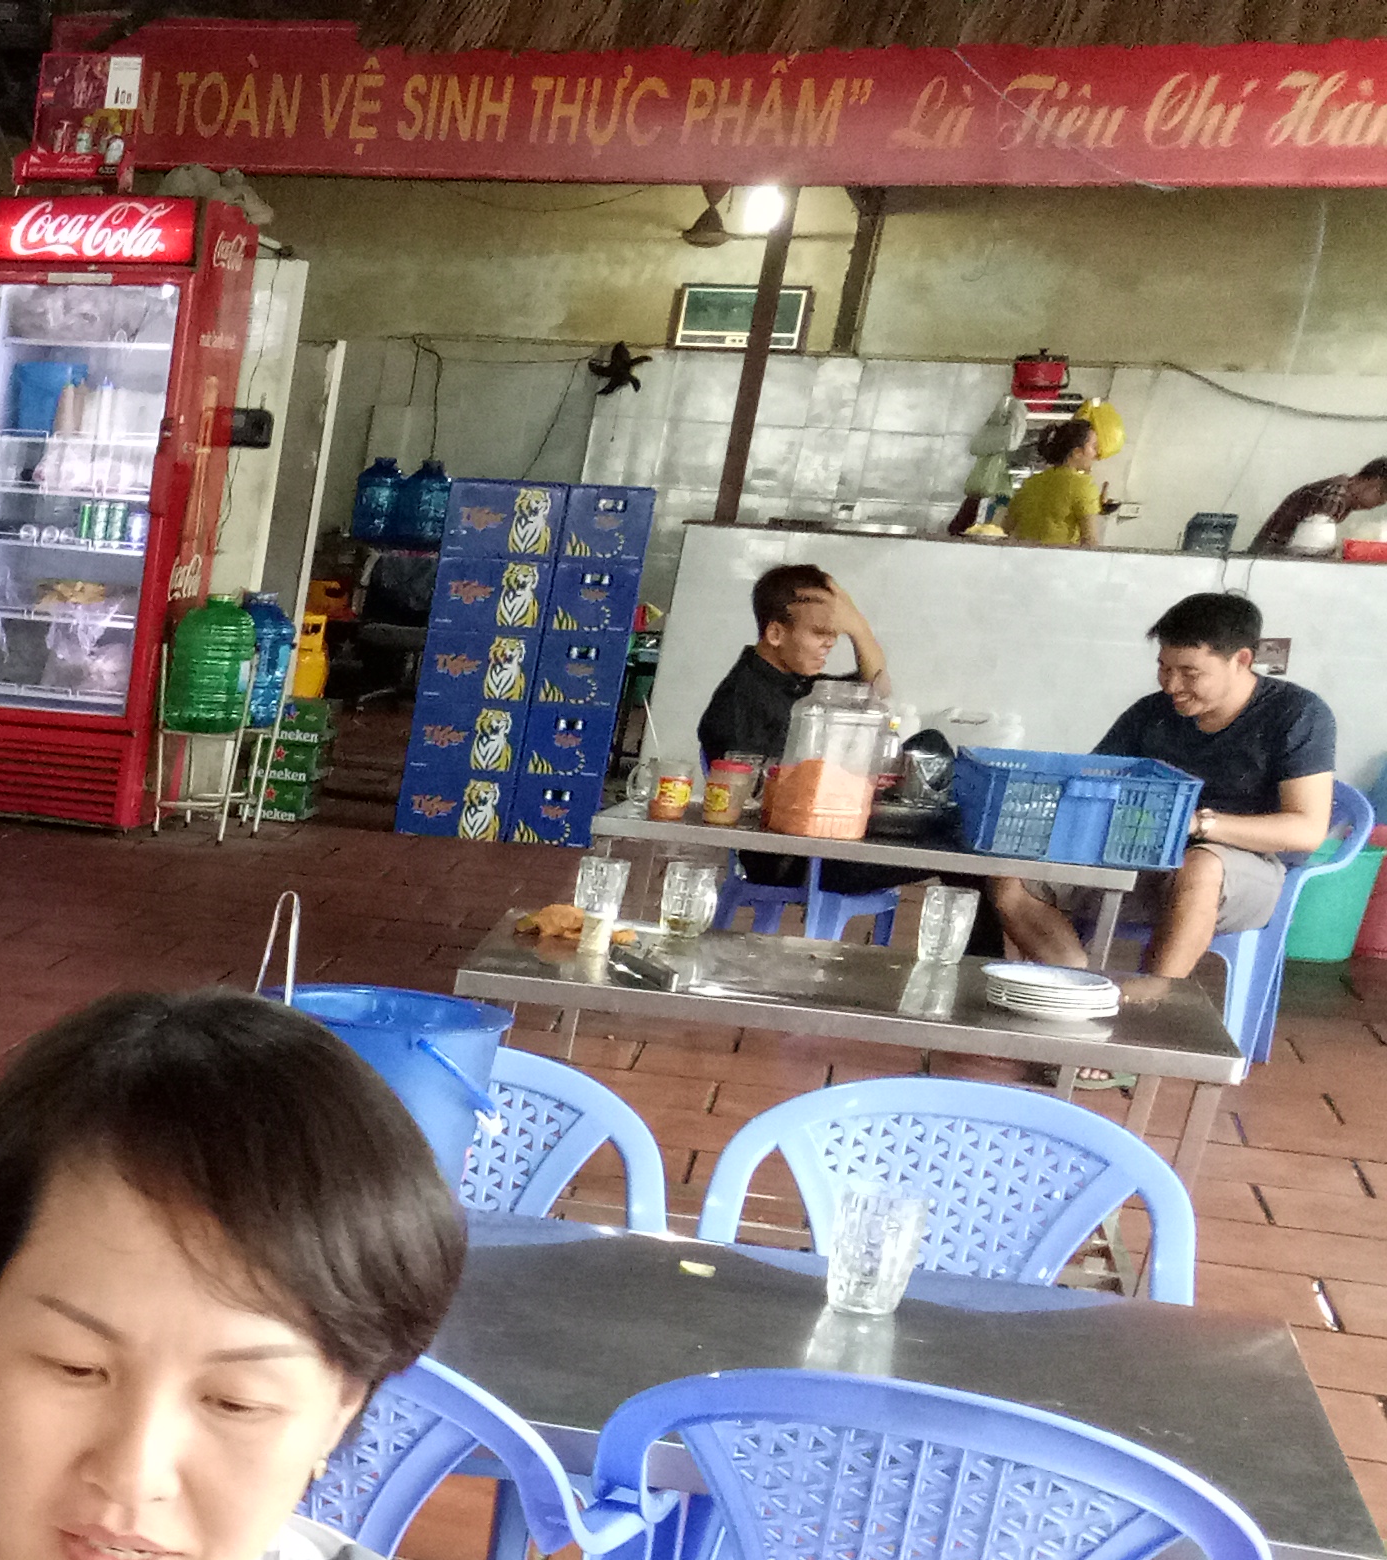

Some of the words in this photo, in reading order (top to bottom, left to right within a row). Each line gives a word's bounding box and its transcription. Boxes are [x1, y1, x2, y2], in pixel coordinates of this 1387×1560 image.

[175, 53, 301, 141] TOÀN
[320, 56, 386, 156] VỆ
[396, 74, 516, 143] SINH
[529, 64, 670, 157] THỰC
[10, 200, 175, 257] Coca-Cola
